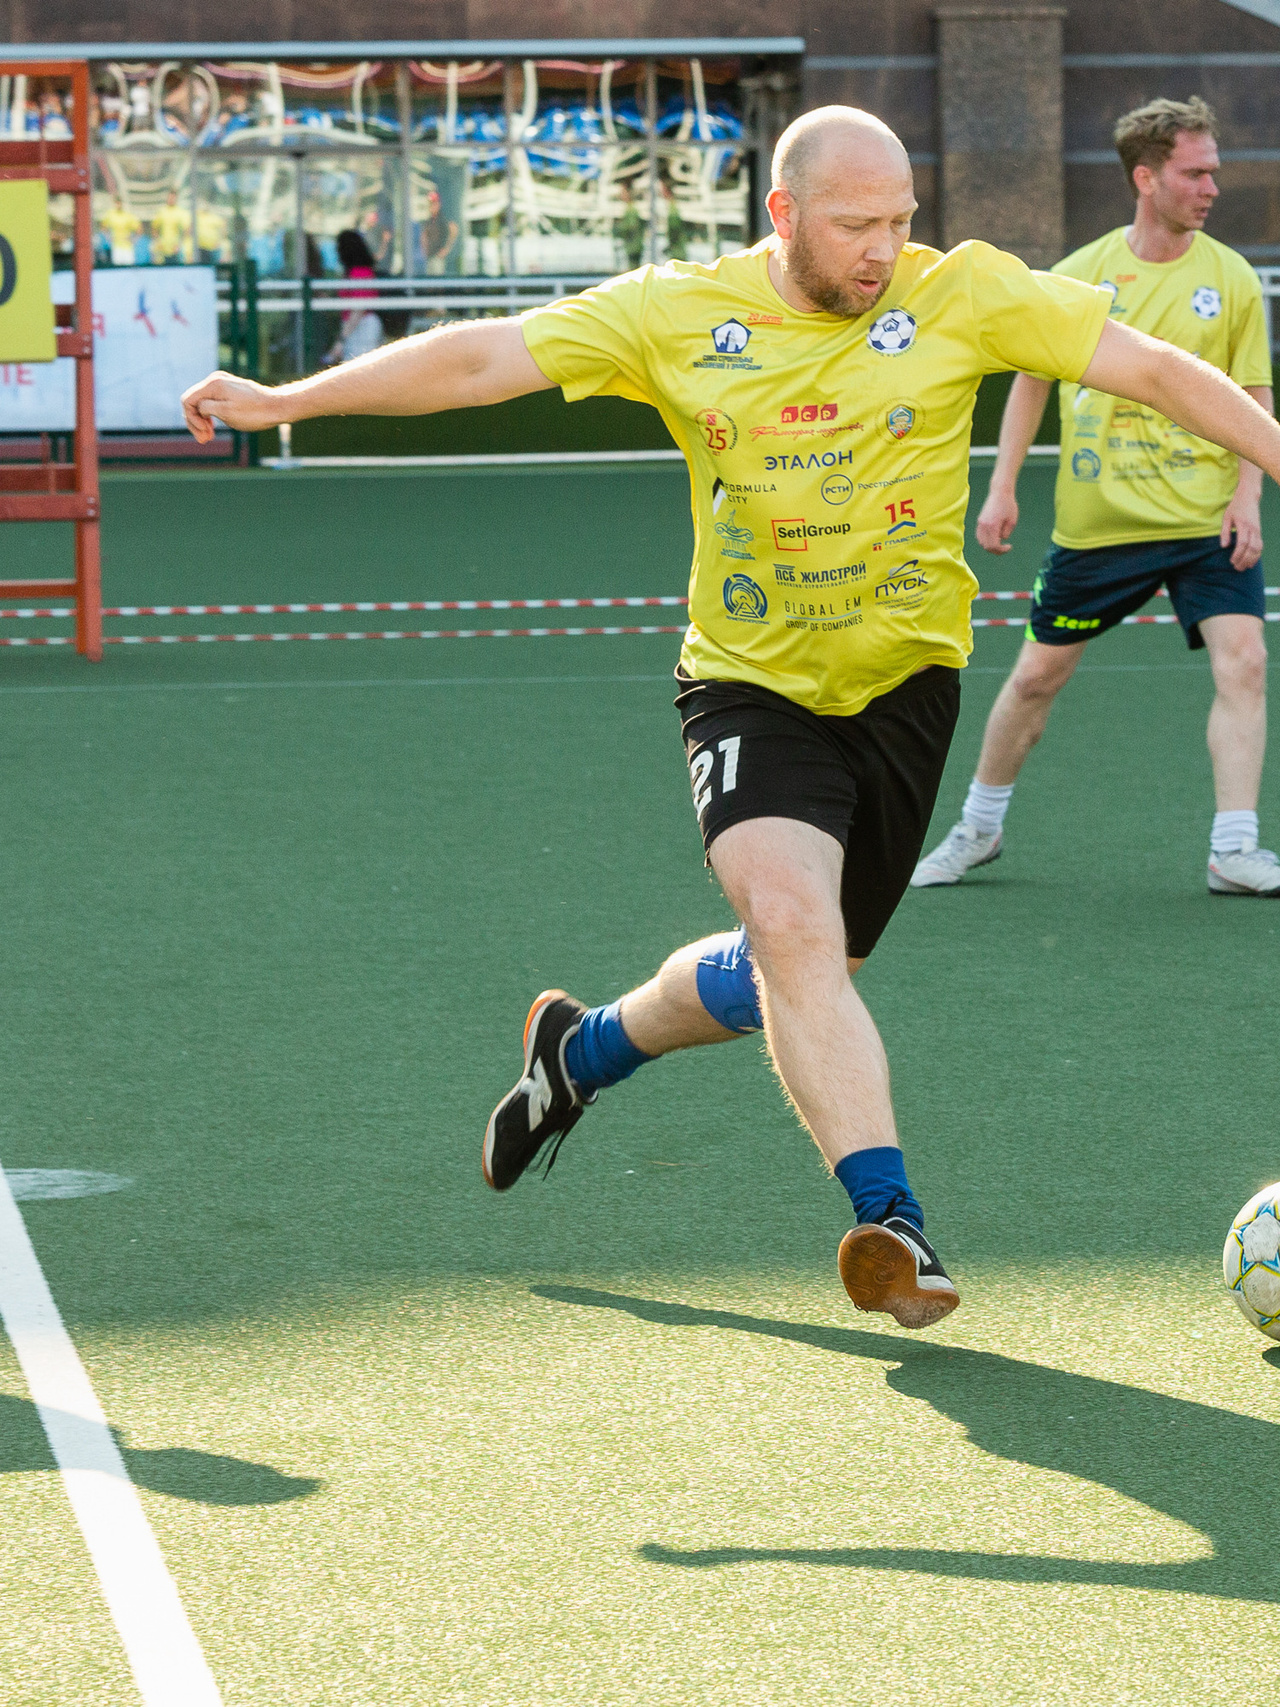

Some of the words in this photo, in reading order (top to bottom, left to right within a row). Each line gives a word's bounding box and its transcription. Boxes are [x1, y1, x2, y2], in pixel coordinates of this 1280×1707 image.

[782, 407, 835, 422] ЛСР
[705, 427, 727, 451] 25
[764, 450, 853, 471] ЭТАЛОН
[725, 483, 778, 494] FORMULA
[825, 485, 850, 495] РСТИ
[858, 472, 926, 490] Росстройинвест
[728, 495, 748, 505] CITY
[884, 499, 916, 524] 15
[775, 569, 796, 582] ПСБ
[800, 560, 867, 584] ЖИЛСТРОЙ
[875, 572, 928, 598] ПУСК
[785, 600, 836, 616] GLOBAL
[846, 596, 861, 611] EM
[785, 620, 808, 630] GROUP
[810, 622, 819, 632] OF
[821, 614, 864, 632] COMPANIES
[690, 735, 741, 823] 21
